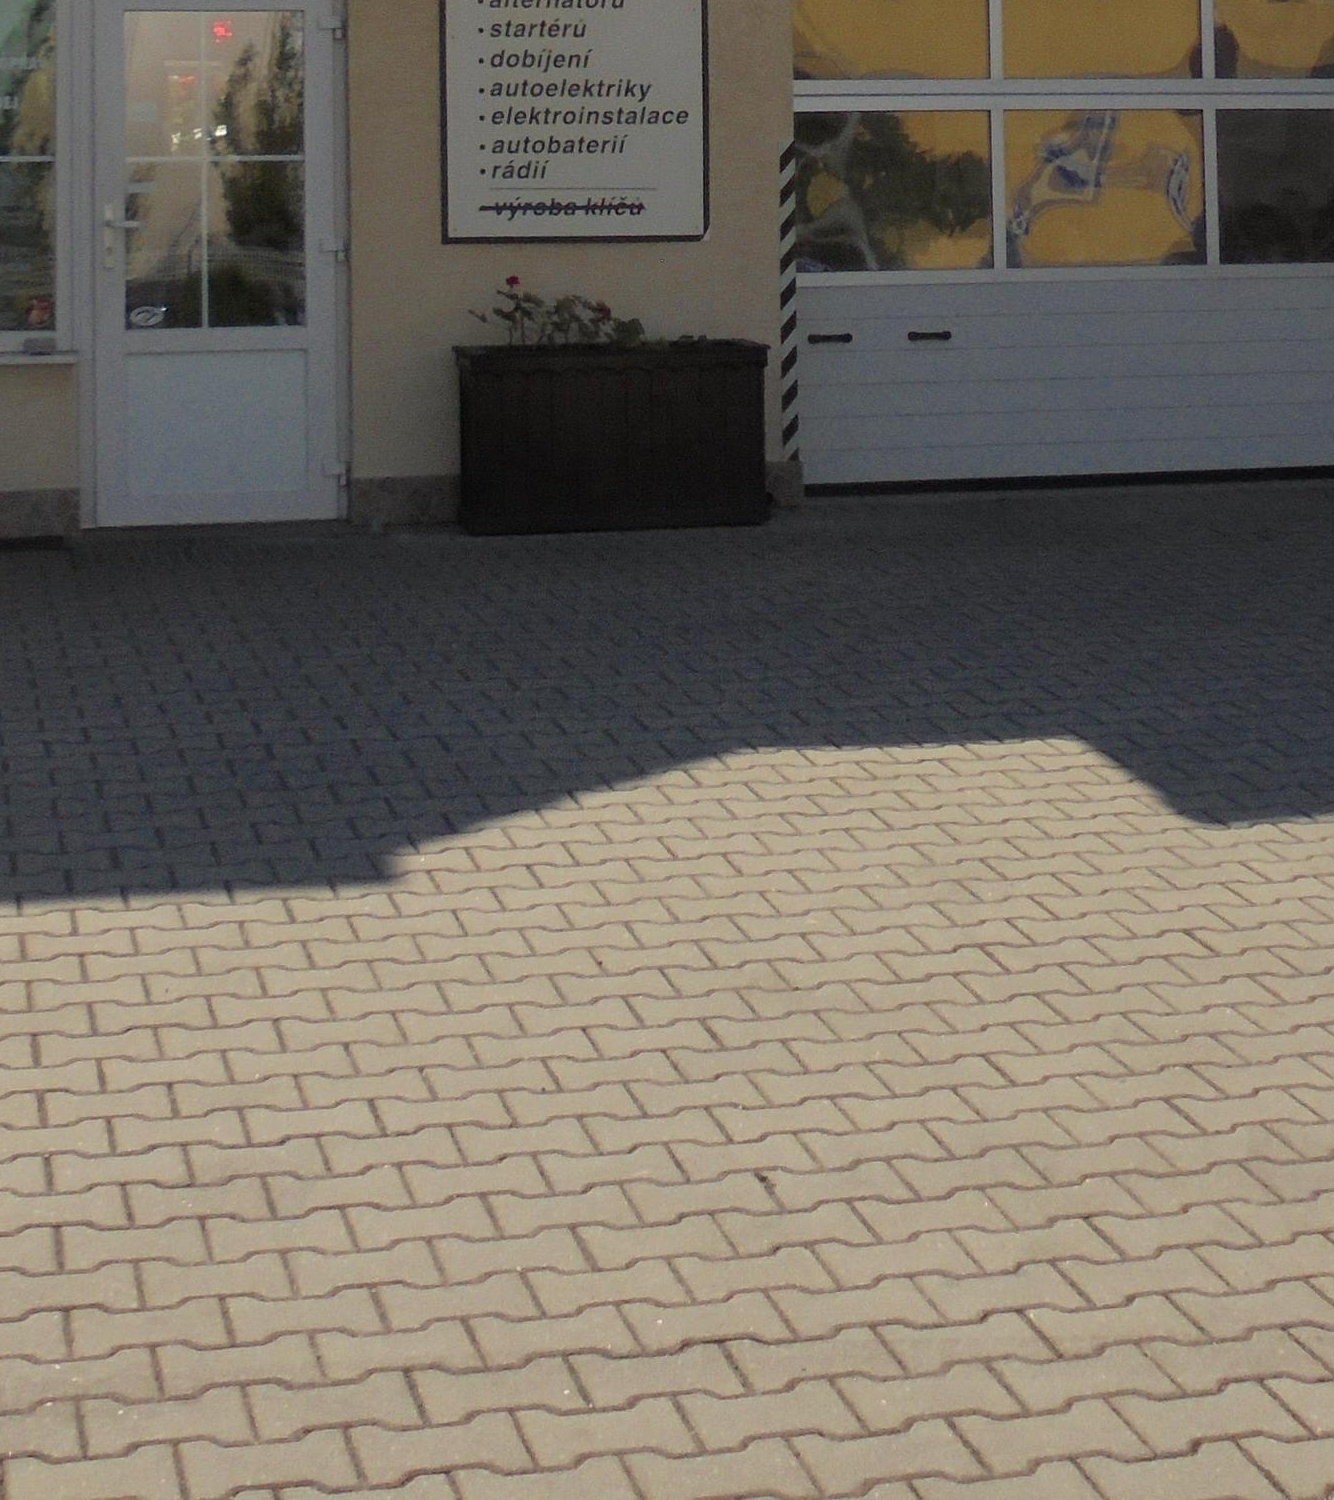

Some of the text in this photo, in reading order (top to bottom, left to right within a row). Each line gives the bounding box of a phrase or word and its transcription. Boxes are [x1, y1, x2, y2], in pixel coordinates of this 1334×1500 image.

[490, 18, 587, 38] startérů
[490, 48, 591, 72] dobíjení
[490, 79, 652, 102] autoelektriky
[491, 106, 689, 125] elektroinstalace
[492, 135, 628, 153] autobaterií
[492, 160, 549, 179] rádií
[495, 196, 576, 221] výroba
